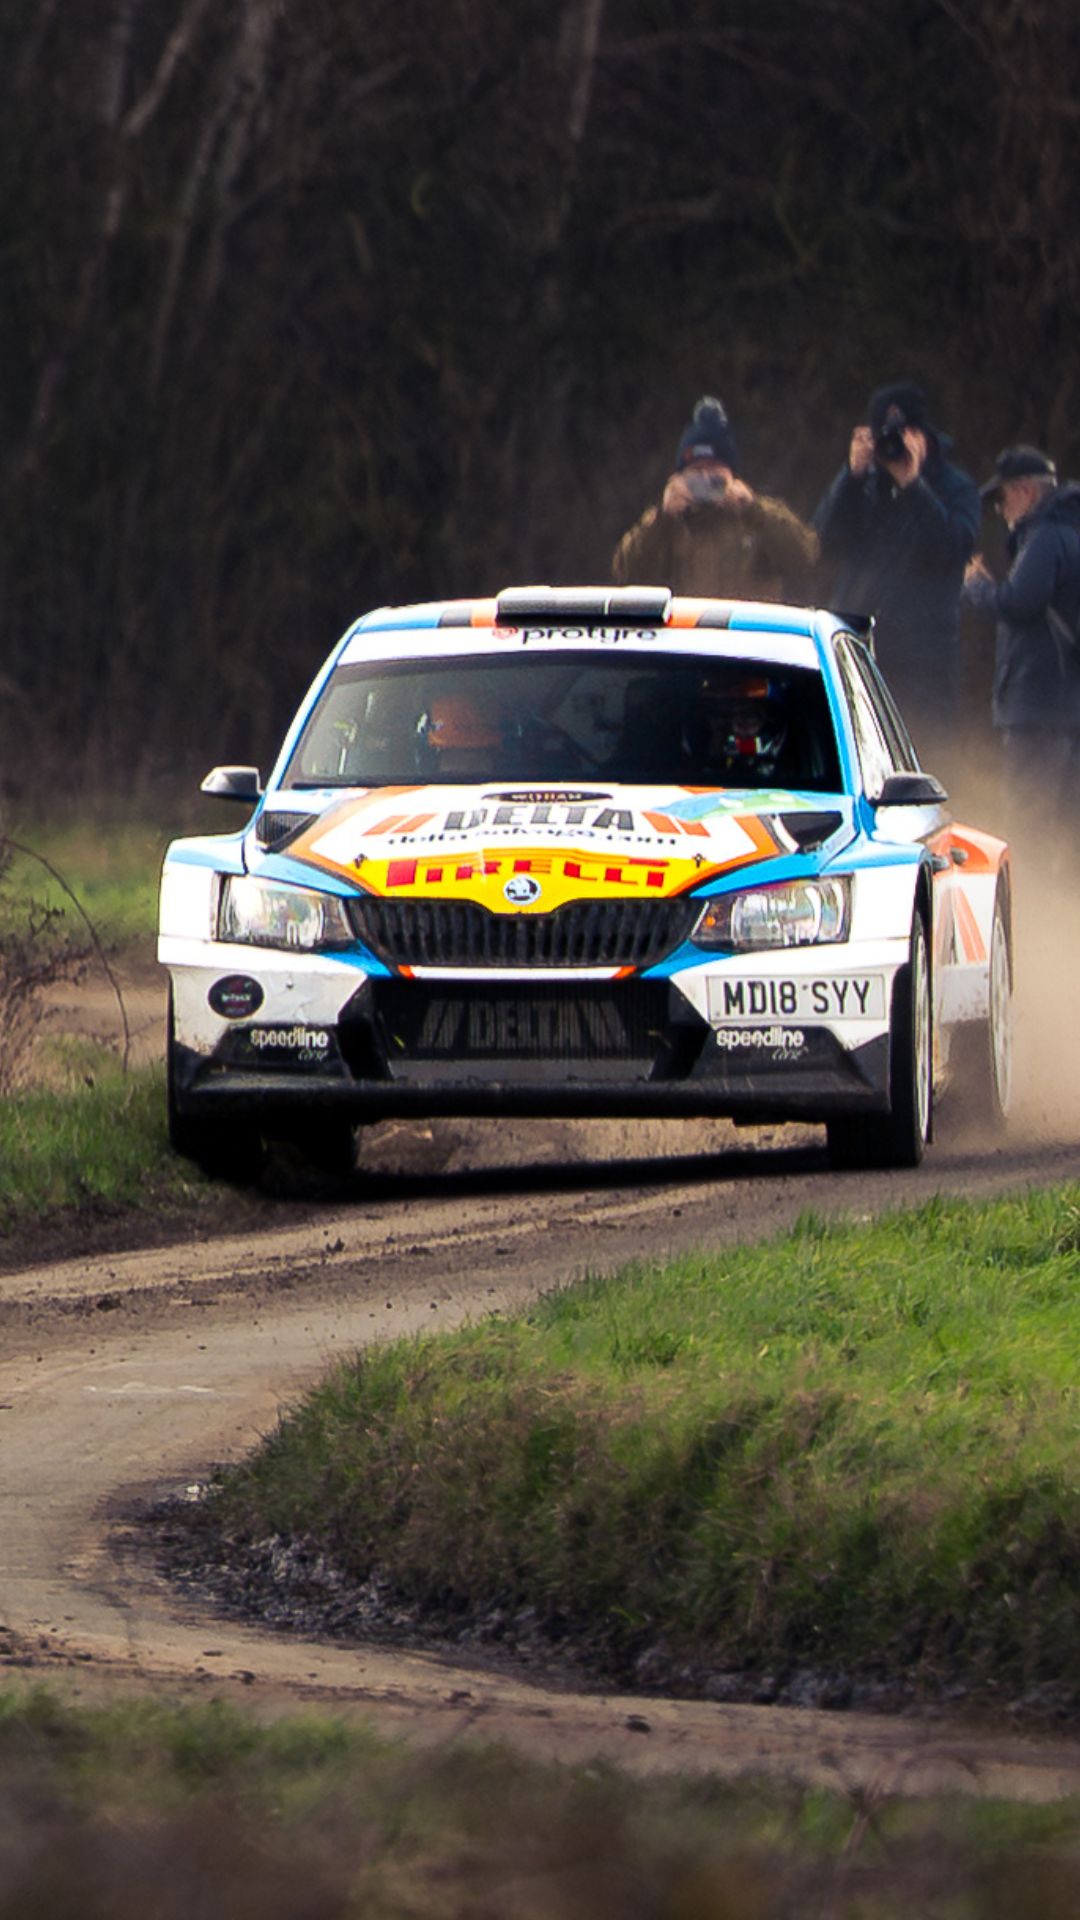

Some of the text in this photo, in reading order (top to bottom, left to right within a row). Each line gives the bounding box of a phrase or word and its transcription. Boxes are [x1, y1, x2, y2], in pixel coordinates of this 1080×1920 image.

[444, 804, 635, 831] DELTA
[723, 980, 870, 1015] MD18 SYY
[250, 1026, 329, 1049] speedline
[467, 1000, 583, 1049] DELTA
[716, 1025, 804, 1050] speedline
